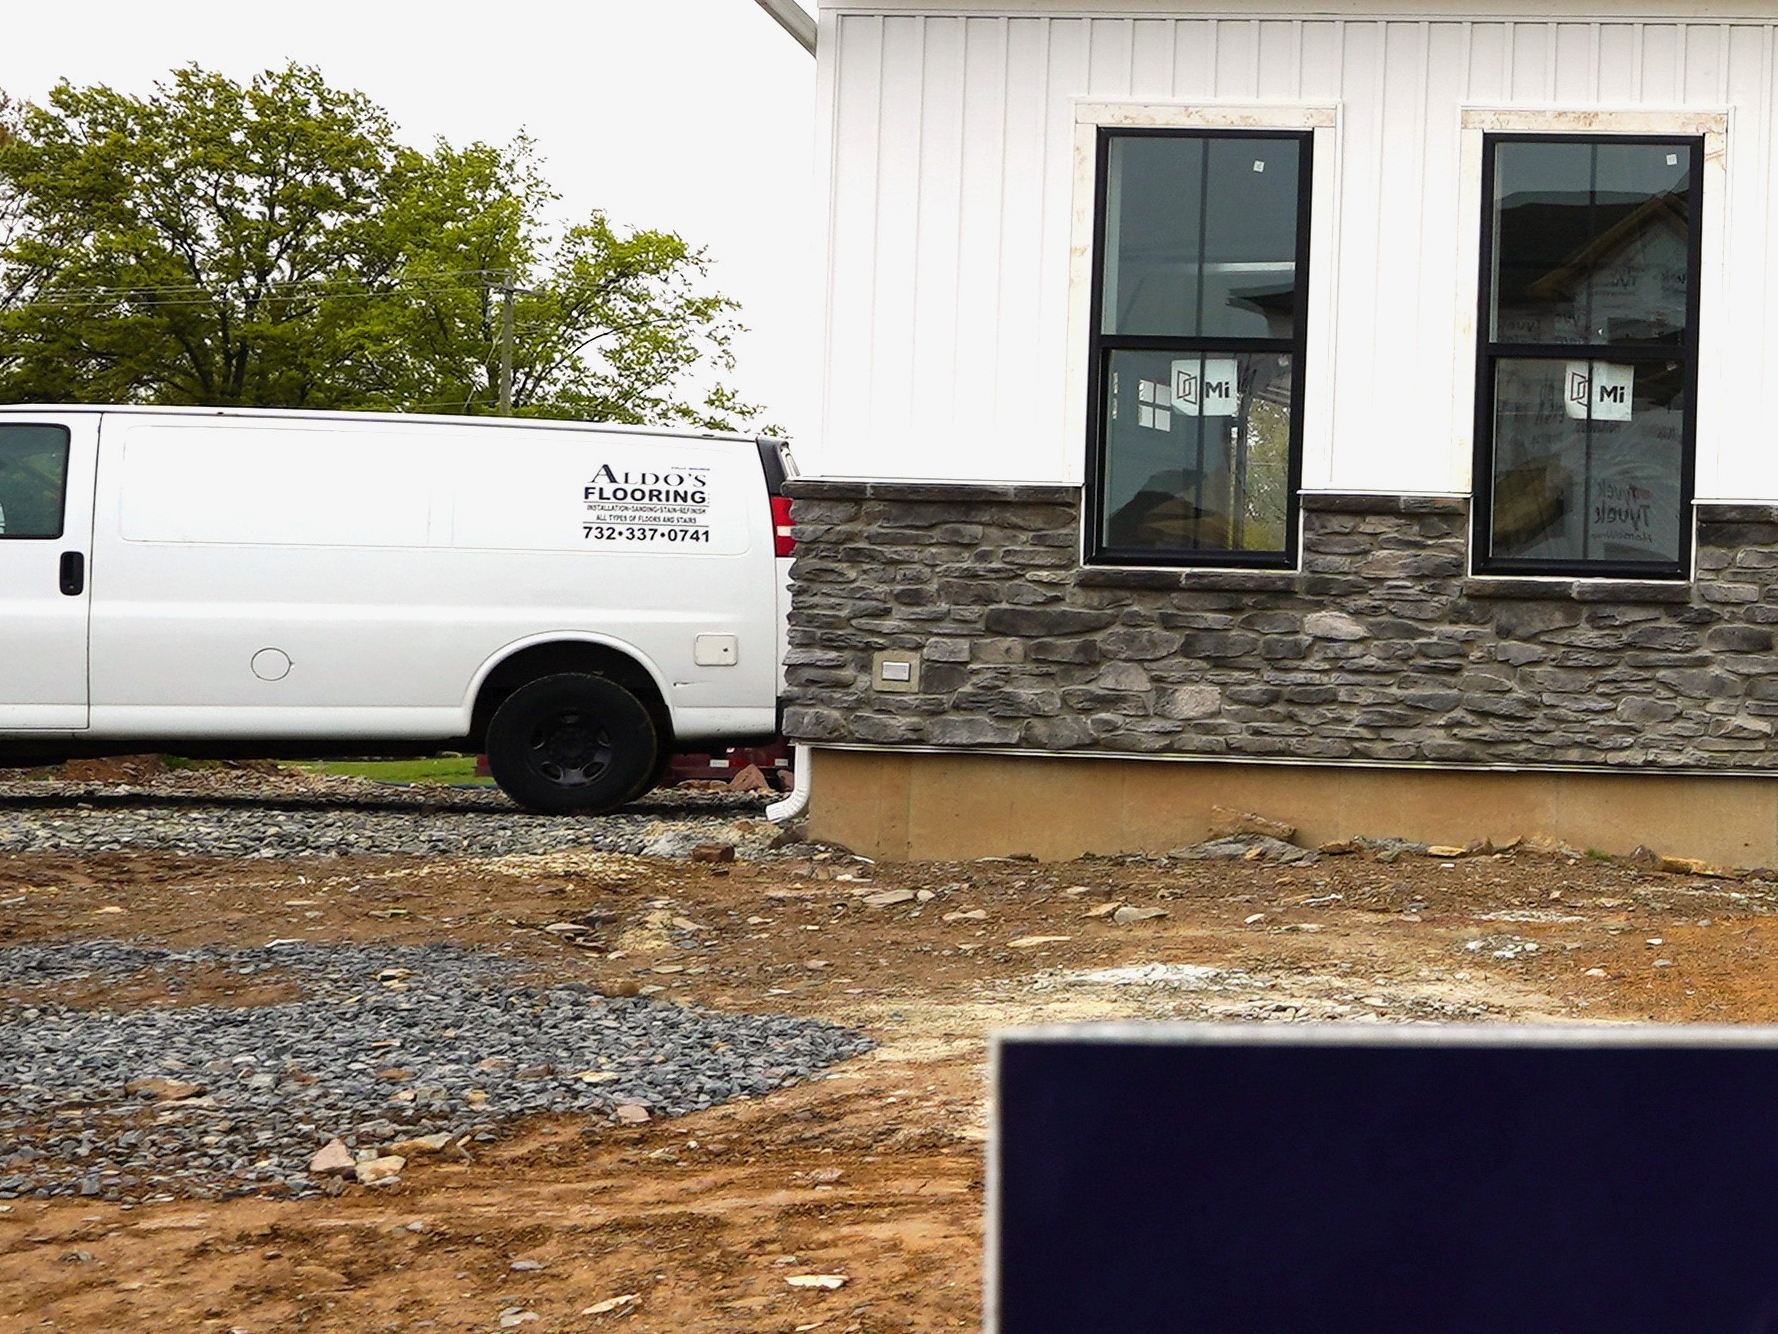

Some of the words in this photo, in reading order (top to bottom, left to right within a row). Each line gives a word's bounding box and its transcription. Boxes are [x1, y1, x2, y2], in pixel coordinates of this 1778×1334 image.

[584, 486, 706, 504] FLOORING
[609, 514, 627, 522] TYPES
[638, 515, 661, 523] FLOORS
[662, 516, 675, 524] AND
